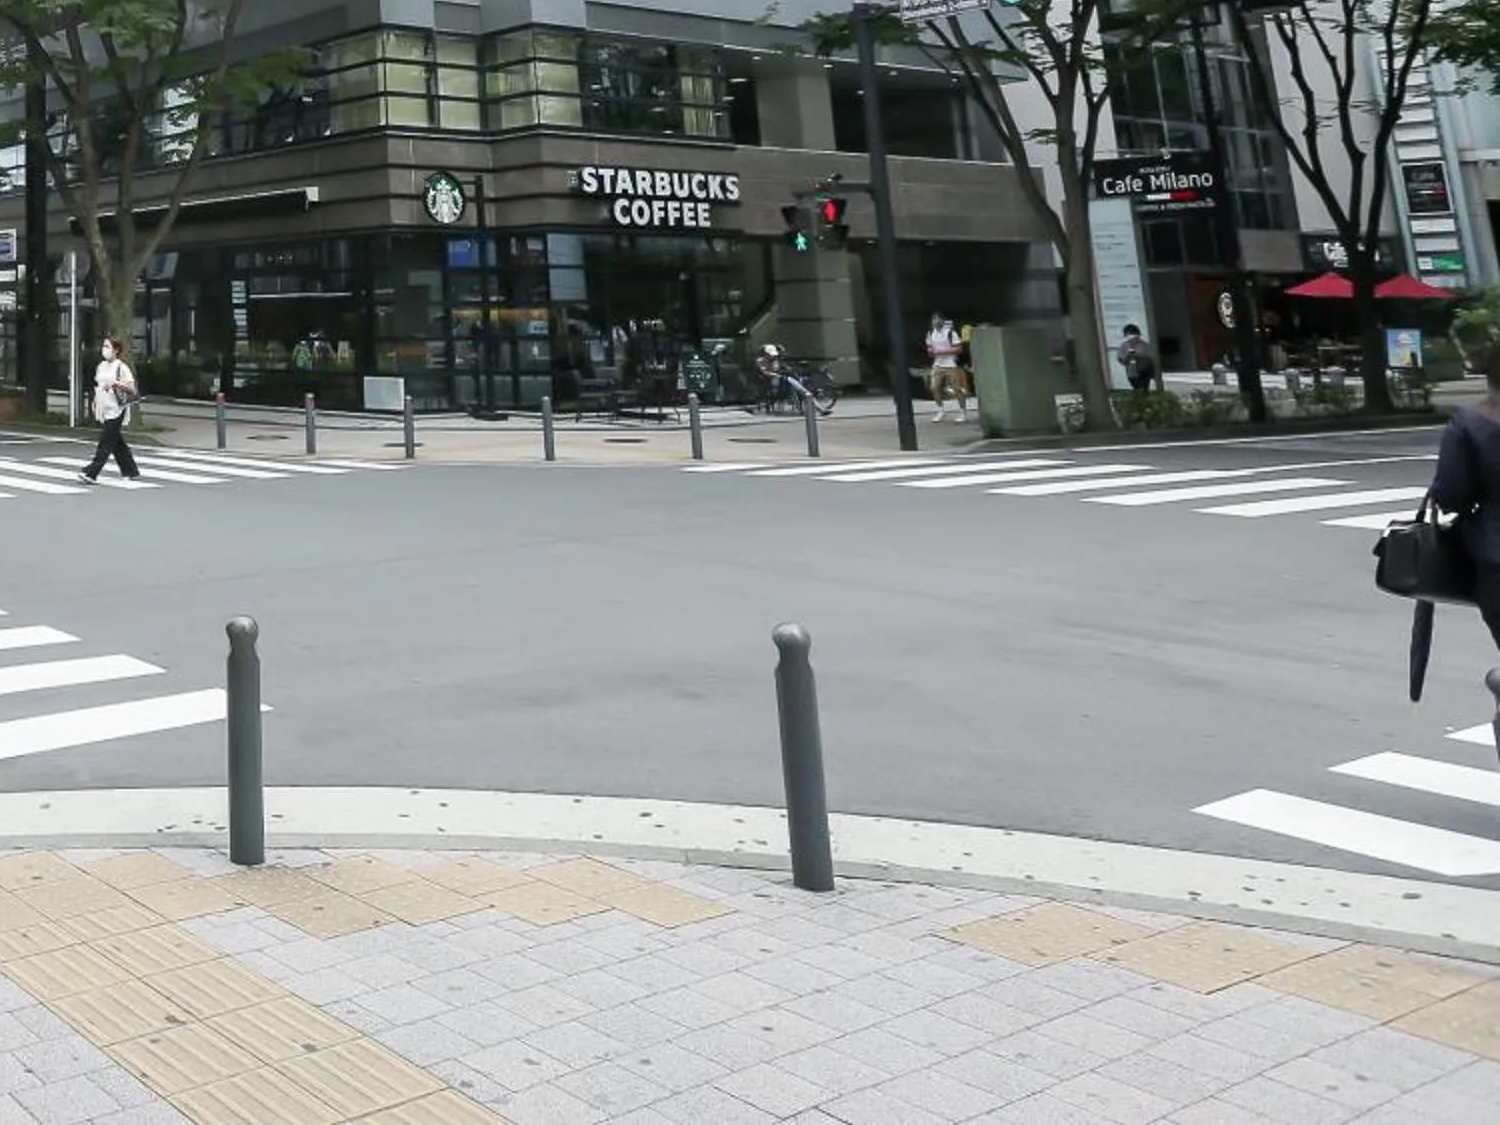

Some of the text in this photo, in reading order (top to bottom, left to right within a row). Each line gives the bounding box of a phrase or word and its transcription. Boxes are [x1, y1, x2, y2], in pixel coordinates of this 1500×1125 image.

[582, 166, 741, 201] STARBUCKS
[1102, 171, 1213, 194] Cafe Milano
[613, 198, 711, 228] COFFEE
